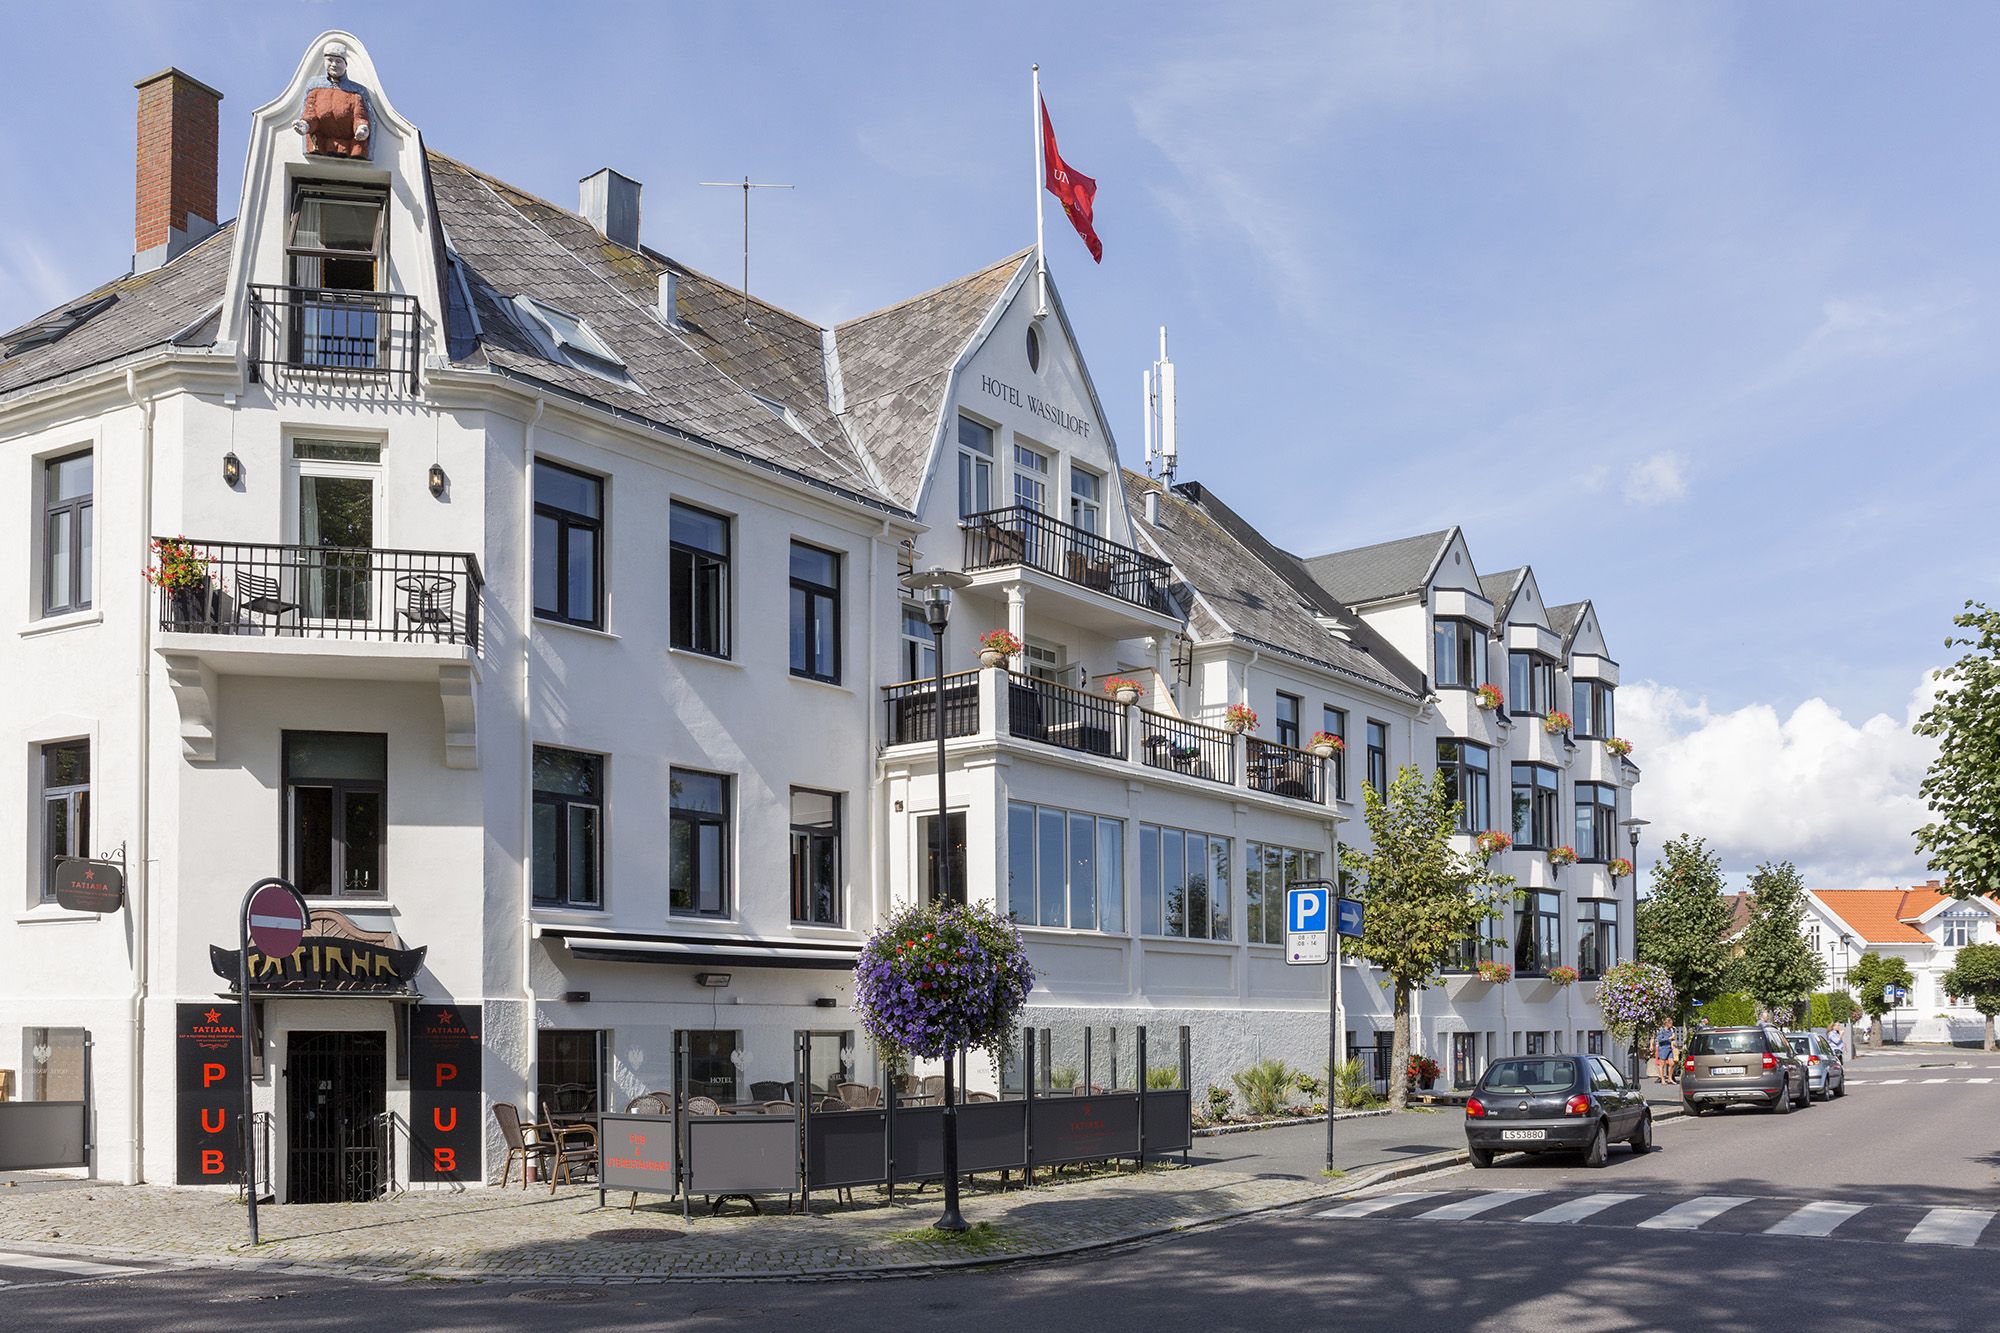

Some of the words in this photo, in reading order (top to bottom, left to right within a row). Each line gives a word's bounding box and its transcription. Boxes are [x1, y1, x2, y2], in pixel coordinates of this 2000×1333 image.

[981, 375, 1023, 408] HOTEL
[1027, 394, 1090, 438] WASSILIOFF
[71, 881, 108, 890] TATIANA
[1297, 893, 1320, 929] P
[710, 1076, 733, 1084] HOTEL
[201, 1063, 226, 1175] PUB
[433, 1063, 457, 1173] PUB
[629, 1135, 646, 1145] PUB
